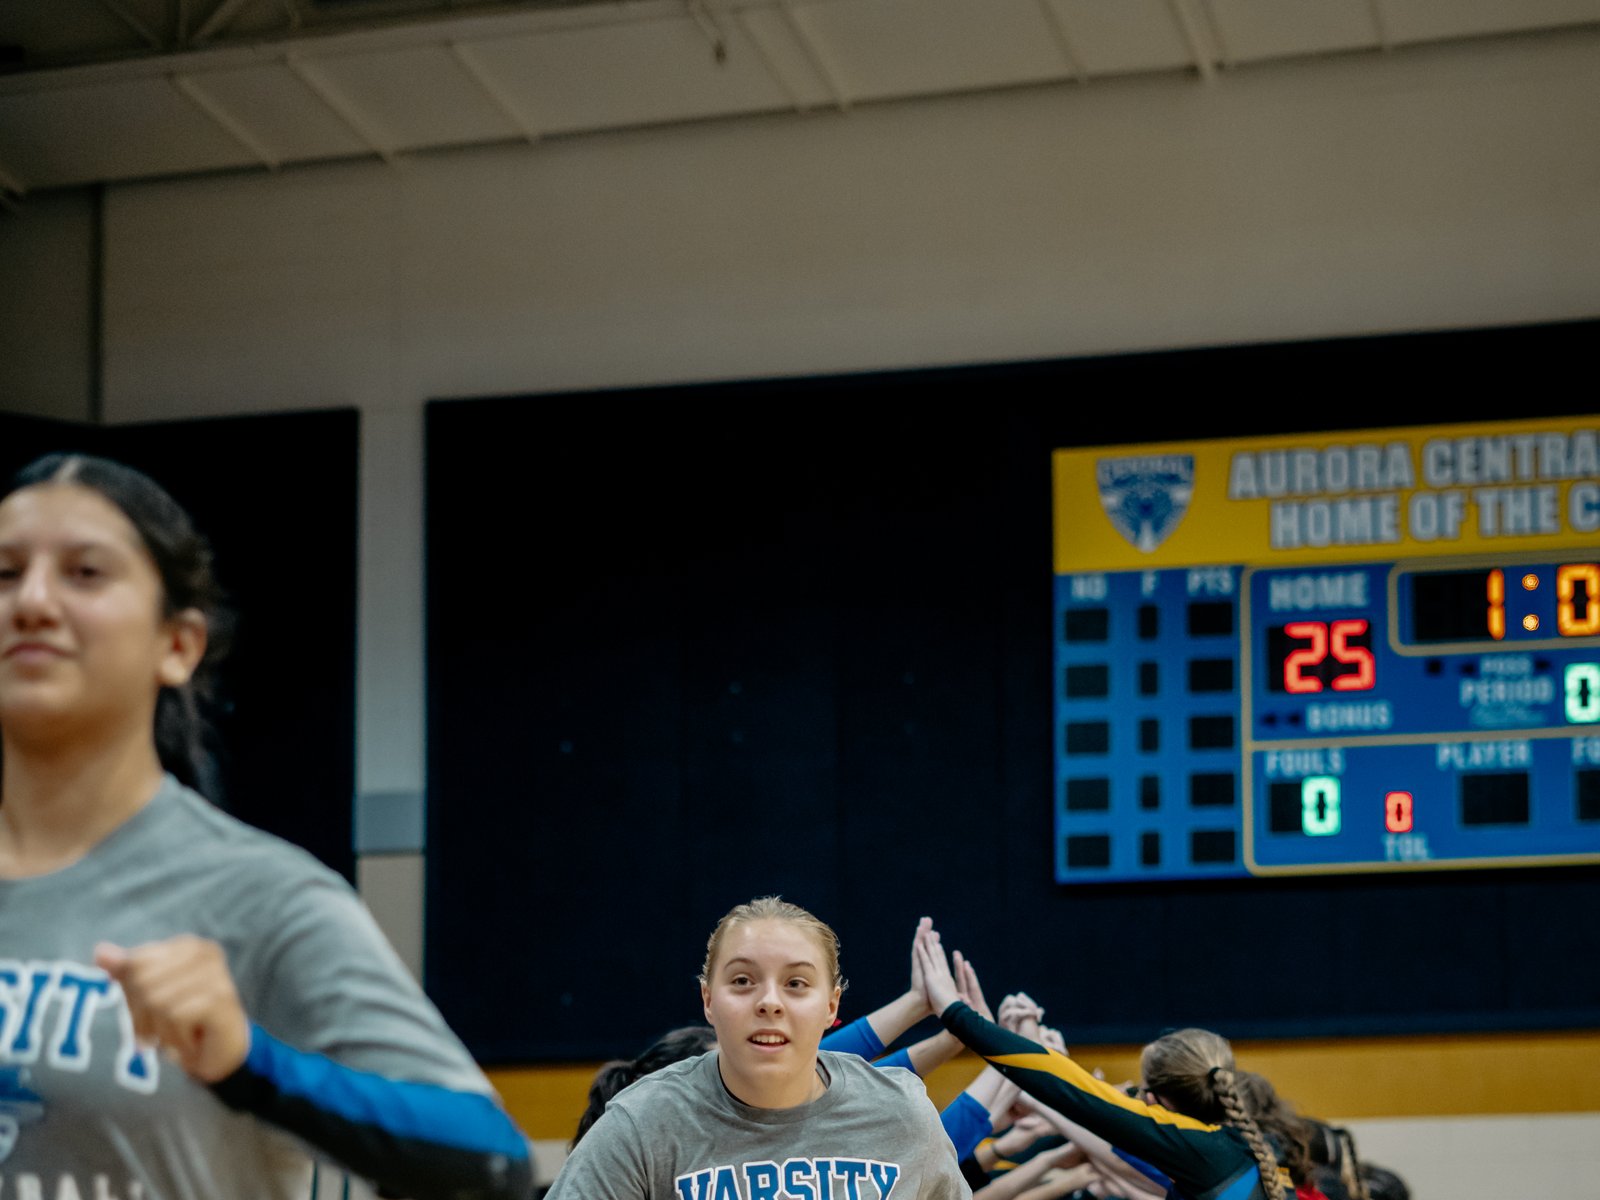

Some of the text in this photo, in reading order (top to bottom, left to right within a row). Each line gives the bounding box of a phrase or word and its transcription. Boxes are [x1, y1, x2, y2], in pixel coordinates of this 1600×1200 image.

[1228, 442, 1416, 499] AURORA
[1270, 492, 1401, 549] HOME
[1409, 489, 1464, 541] OF
[1472, 482, 1561, 538] THE
[1270, 573, 1369, 611] HOME
[1284, 619, 1376, 694] 25
[1459, 675, 1555, 707] PERIOD
[1565, 662, 1600, 724] 0
[1306, 702, 1392, 732] BONUS
[1265, 750, 1344, 777] FOULS
[1436, 741, 1532, 770] PLAYER
[1302, 775, 1341, 836] 0
[1385, 791, 1413, 833] 0
